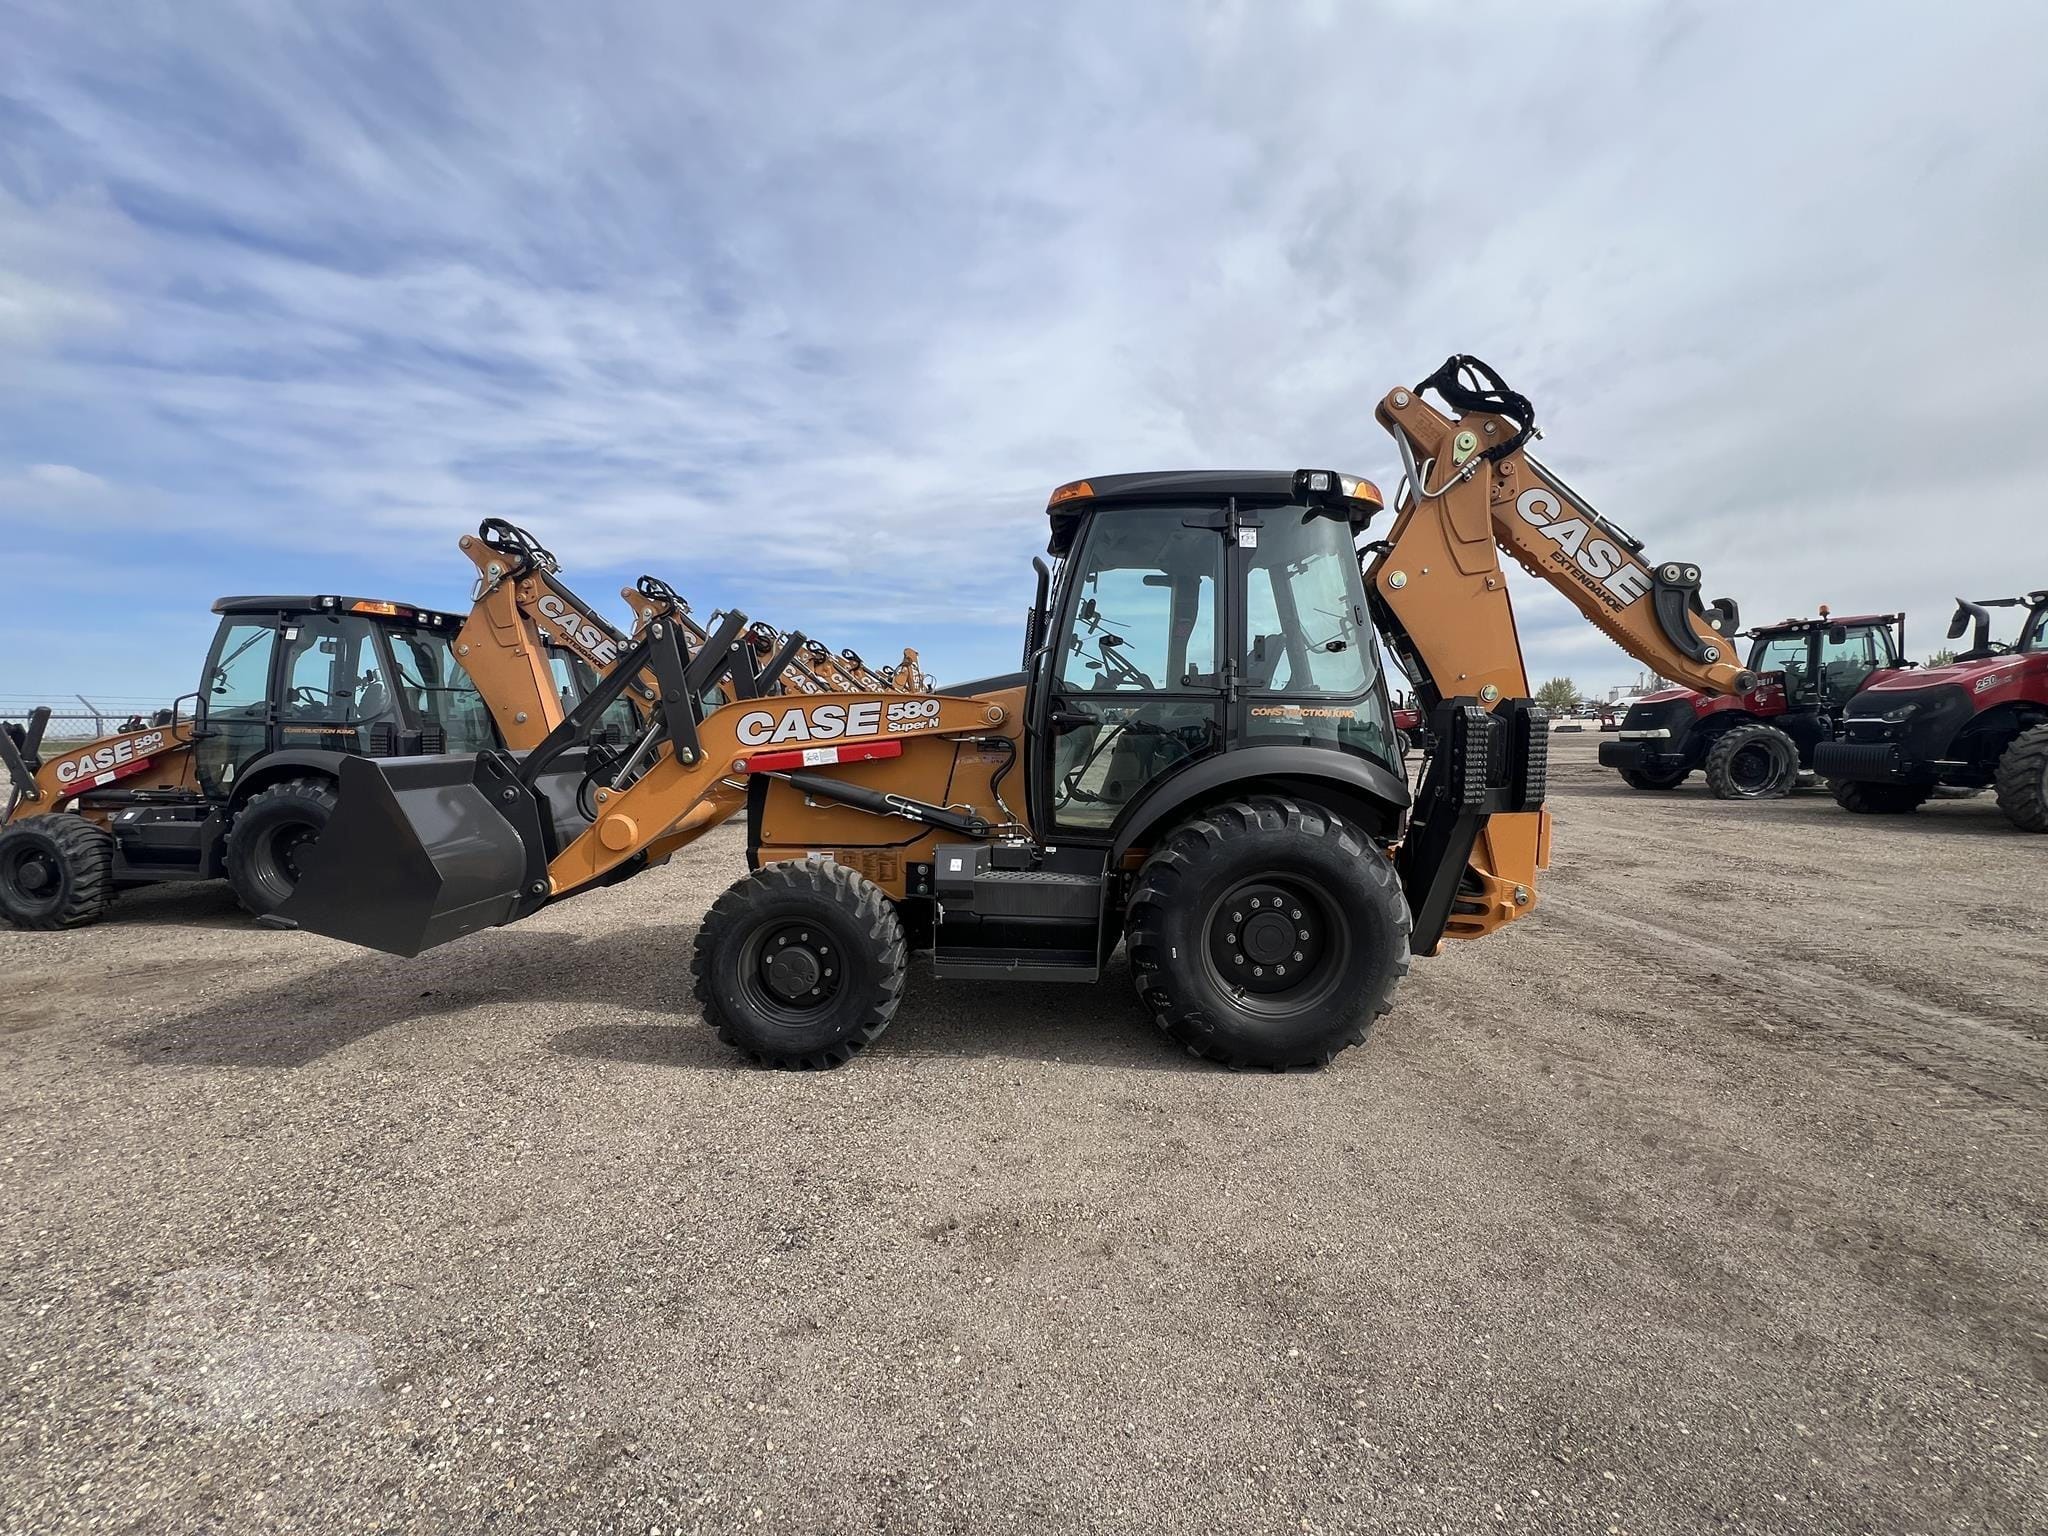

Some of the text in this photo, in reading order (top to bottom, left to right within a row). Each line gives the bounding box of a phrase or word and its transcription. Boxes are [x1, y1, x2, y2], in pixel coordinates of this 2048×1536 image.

[1516, 487, 1654, 607] CASE
[1550, 551, 1625, 613] EXTENDAHOE
[537, 595, 618, 665] CASE
[782, 664, 825, 695] CAS
[831, 673, 860, 693] CA
[1975, 674, 1998, 691] 250
[736, 698, 940, 746] CASE 580
[887, 717, 940, 732] Super N
[1250, 707, 1332, 718] CONSTRUCTION
[56, 739, 133, 783] CASE
[134, 731, 162, 749] 580
